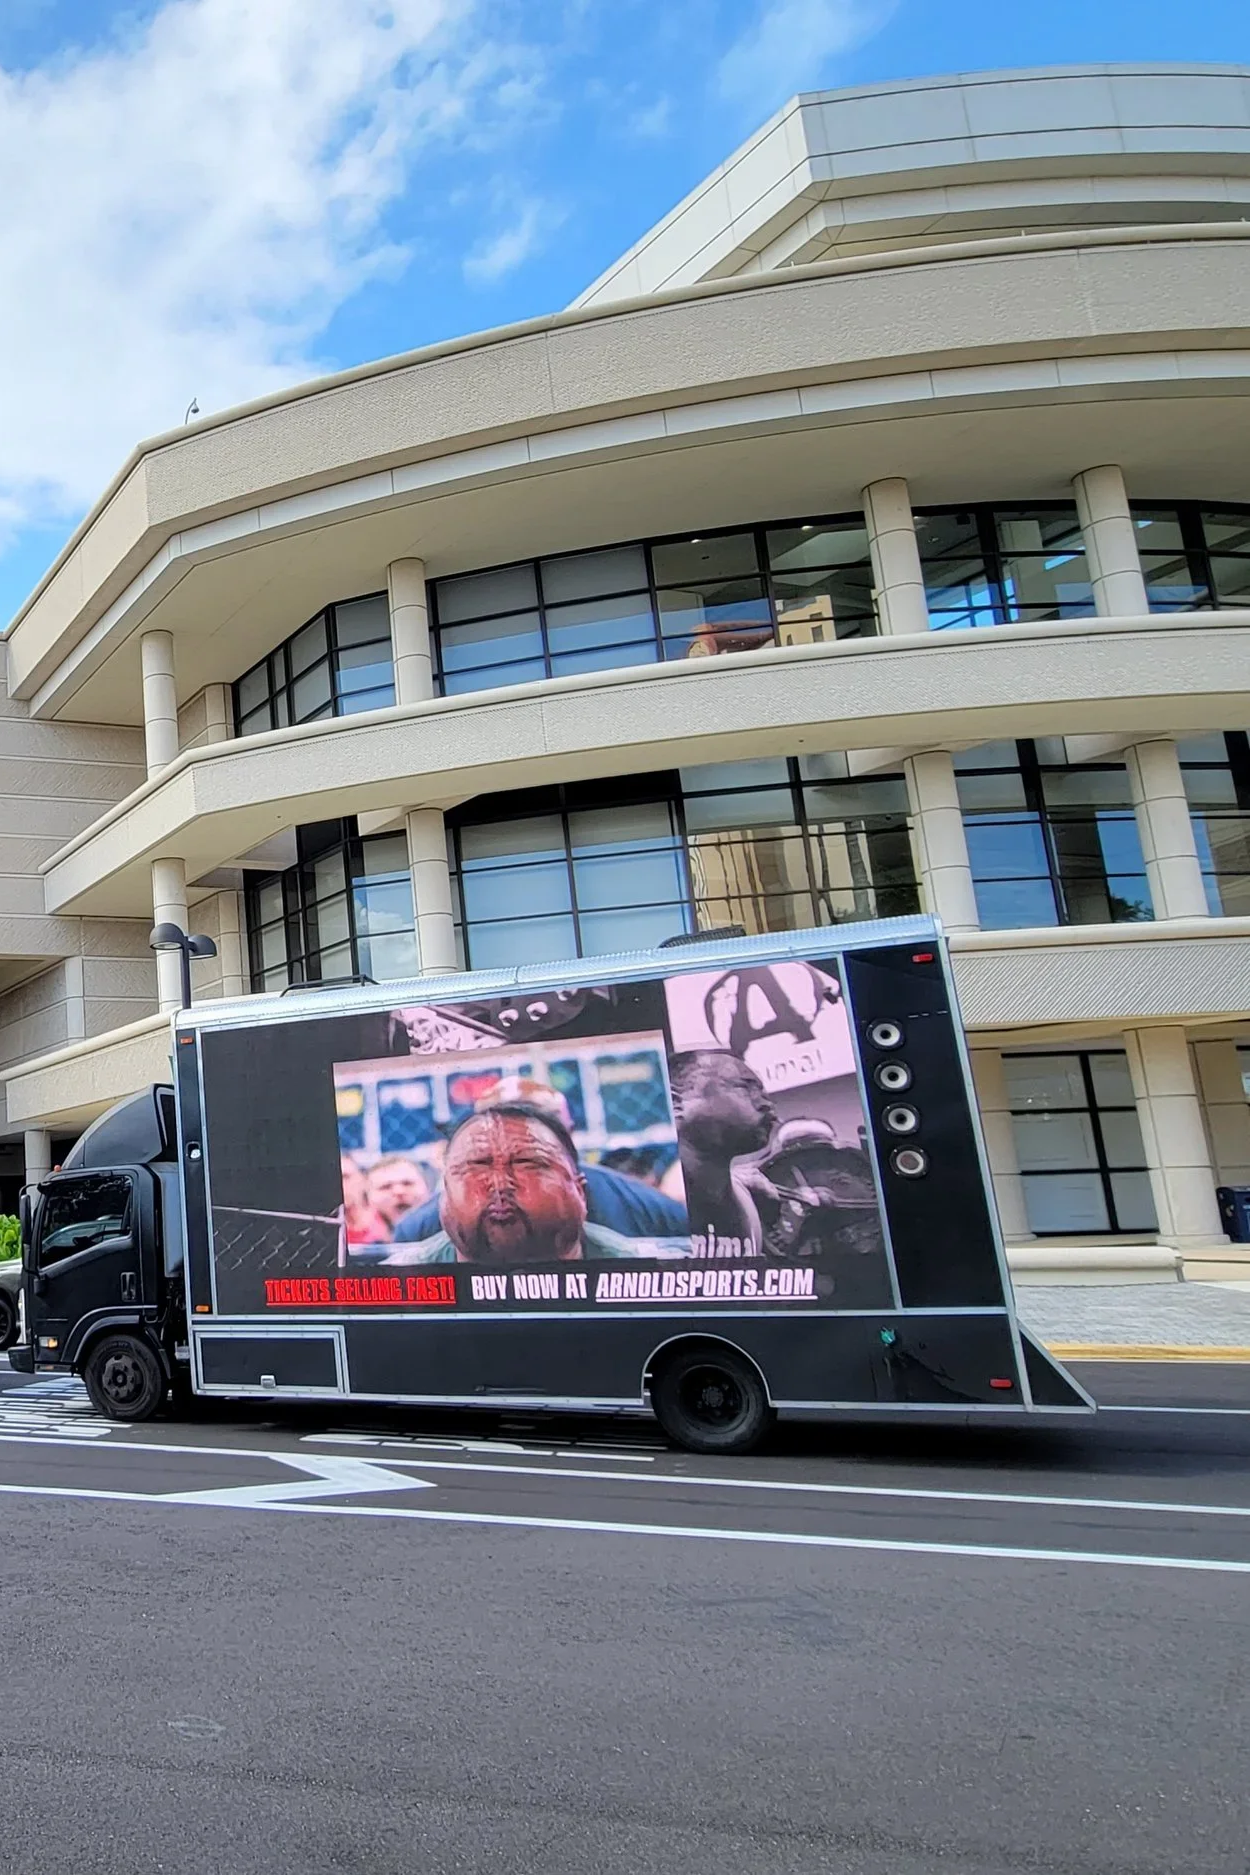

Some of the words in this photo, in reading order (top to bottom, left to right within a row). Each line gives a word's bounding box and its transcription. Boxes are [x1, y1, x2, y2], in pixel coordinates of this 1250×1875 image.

[265, 1279, 329, 1302] TICKETS
[334, 1277, 402, 1301] SELLING
[406, 1276, 456, 1300] FAST!
[471, 1275, 507, 1300] BUY
[513, 1274, 559, 1299] NOW
[565, 1273, 587, 1299] AT
[595, 1268, 815, 1299] ARNOLDSPORTS.COM
